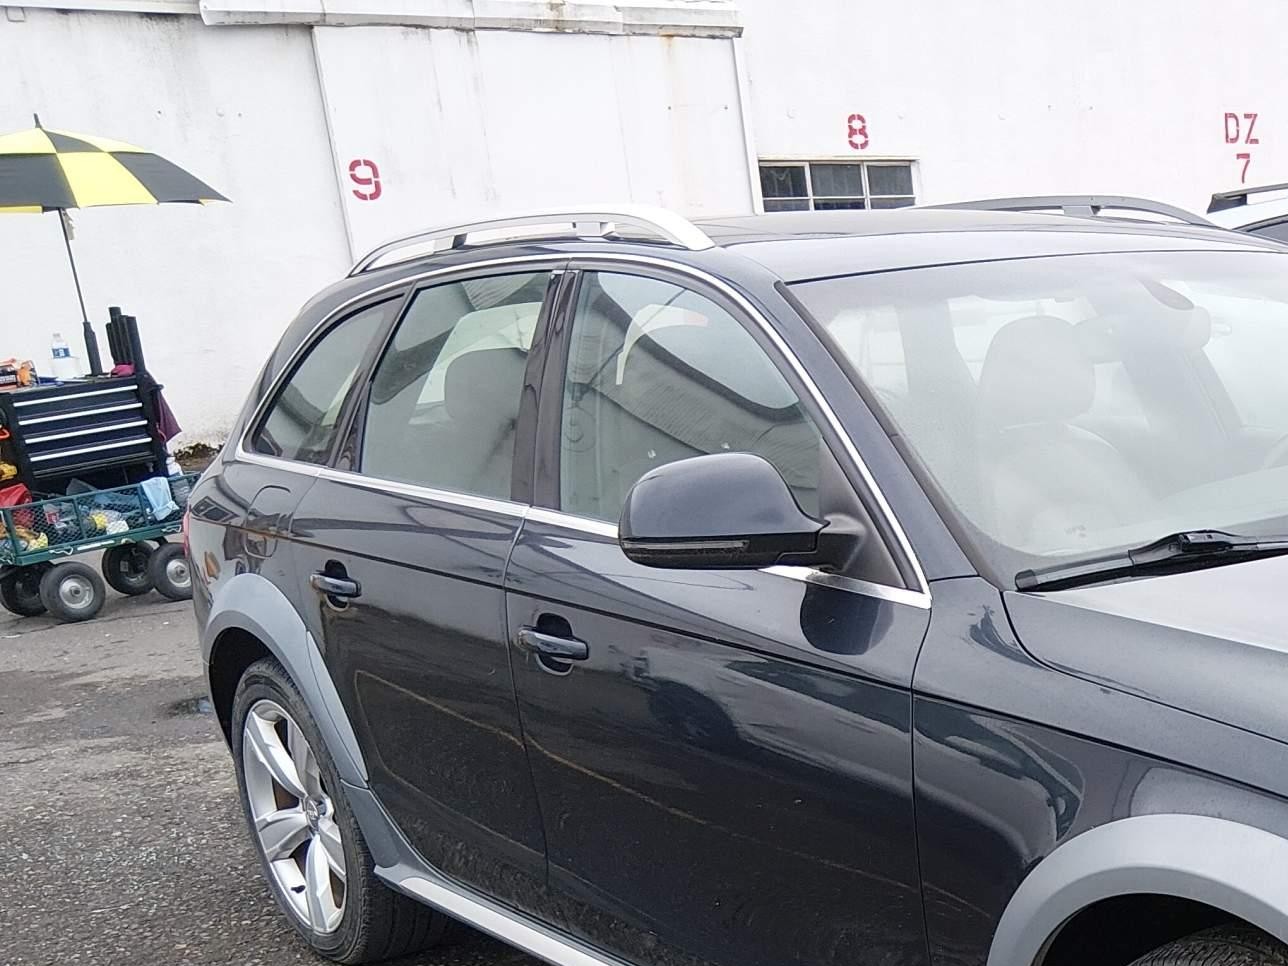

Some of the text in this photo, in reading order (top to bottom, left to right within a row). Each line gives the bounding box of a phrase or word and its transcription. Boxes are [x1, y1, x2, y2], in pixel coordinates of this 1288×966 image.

[847, 113, 870, 151] 8
[1224, 112, 1260, 145] DZ
[347, 158, 383, 202] 9
[1236, 152, 1251, 184] 7
